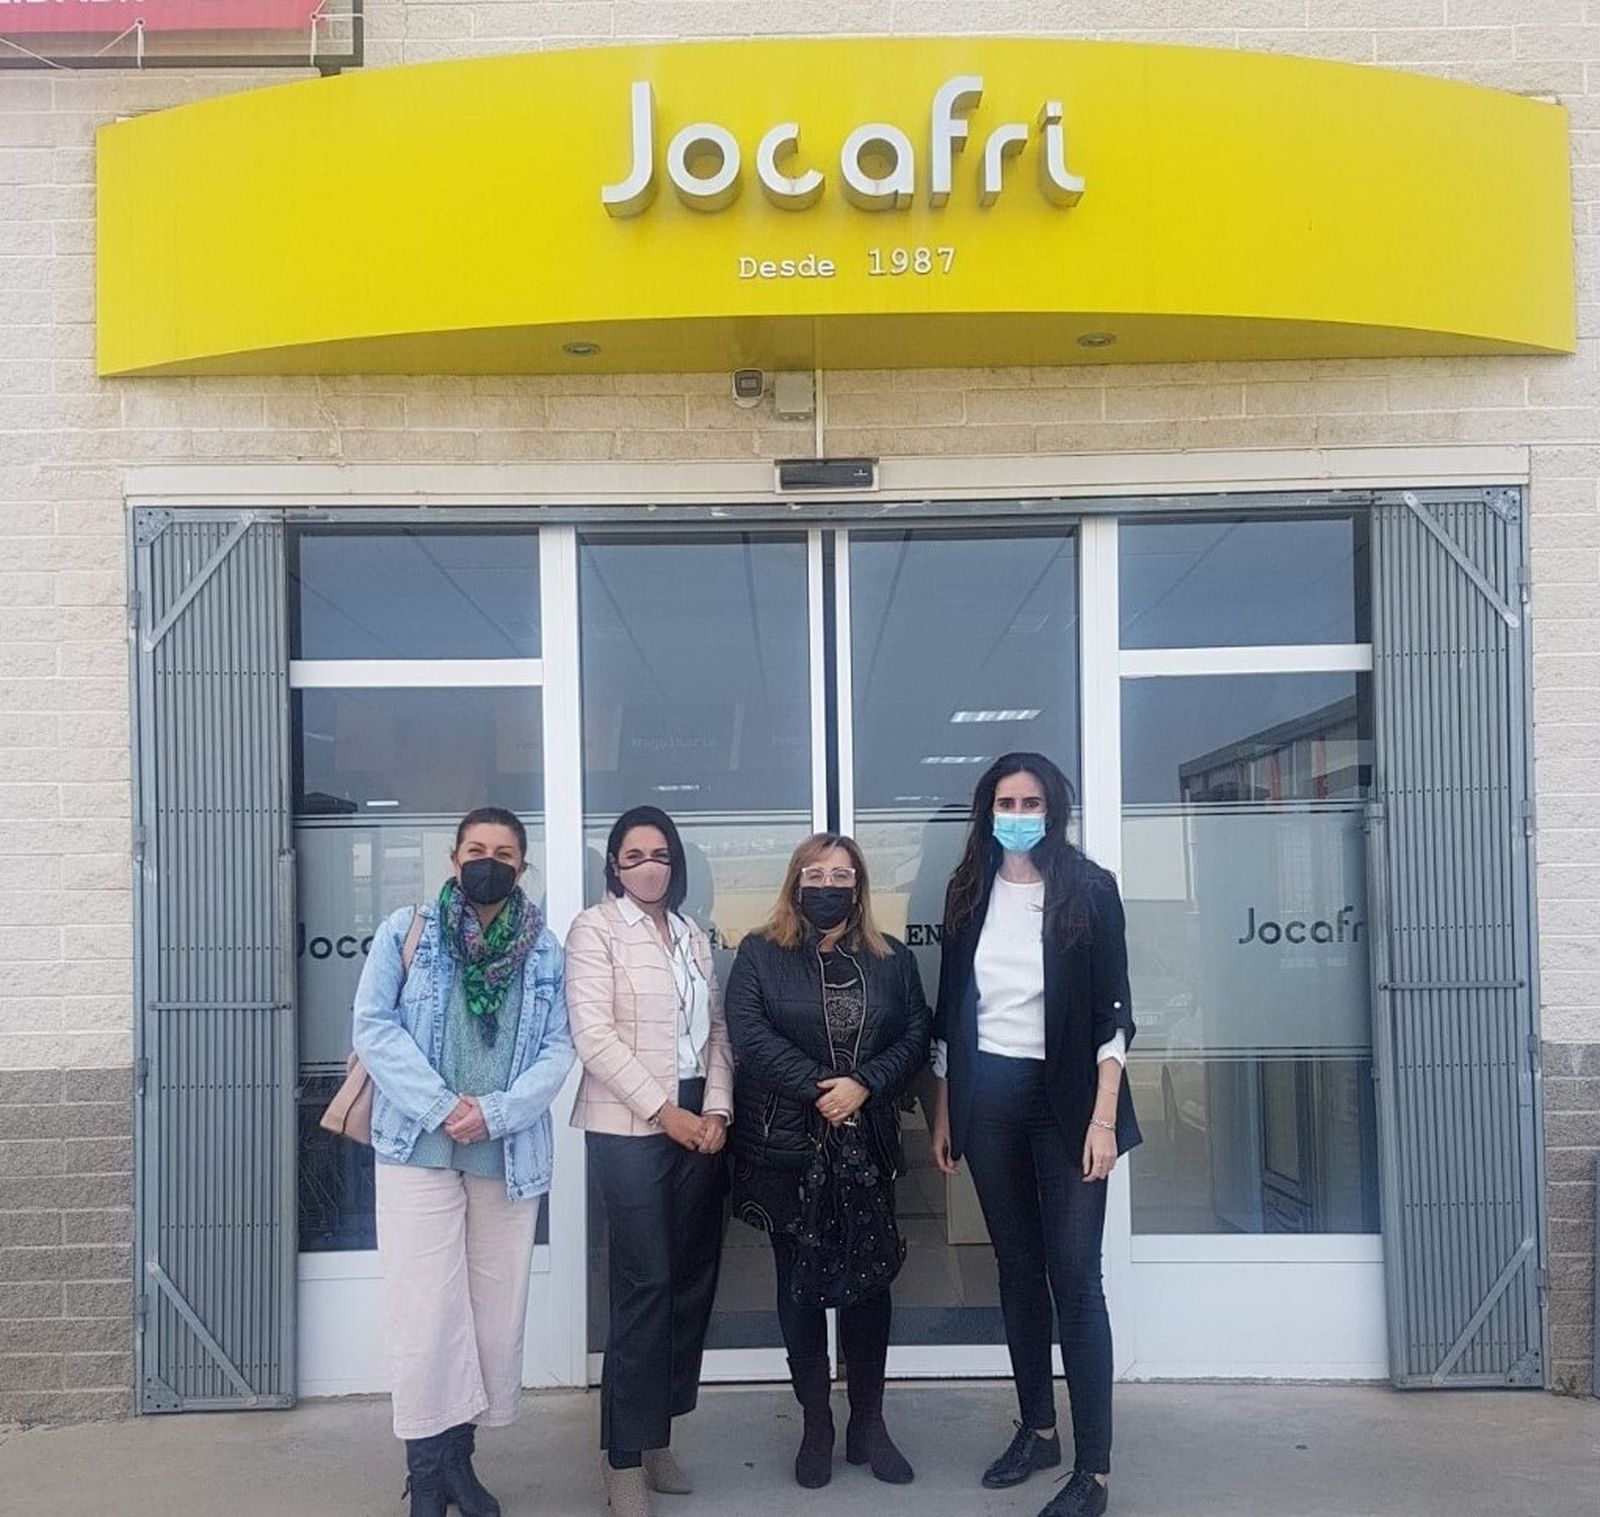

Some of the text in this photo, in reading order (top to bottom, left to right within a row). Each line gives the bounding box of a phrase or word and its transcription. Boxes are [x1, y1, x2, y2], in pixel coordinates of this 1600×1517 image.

[601, 75, 1085, 216] Jocafri
[738, 247, 956, 279] Desde 1987
